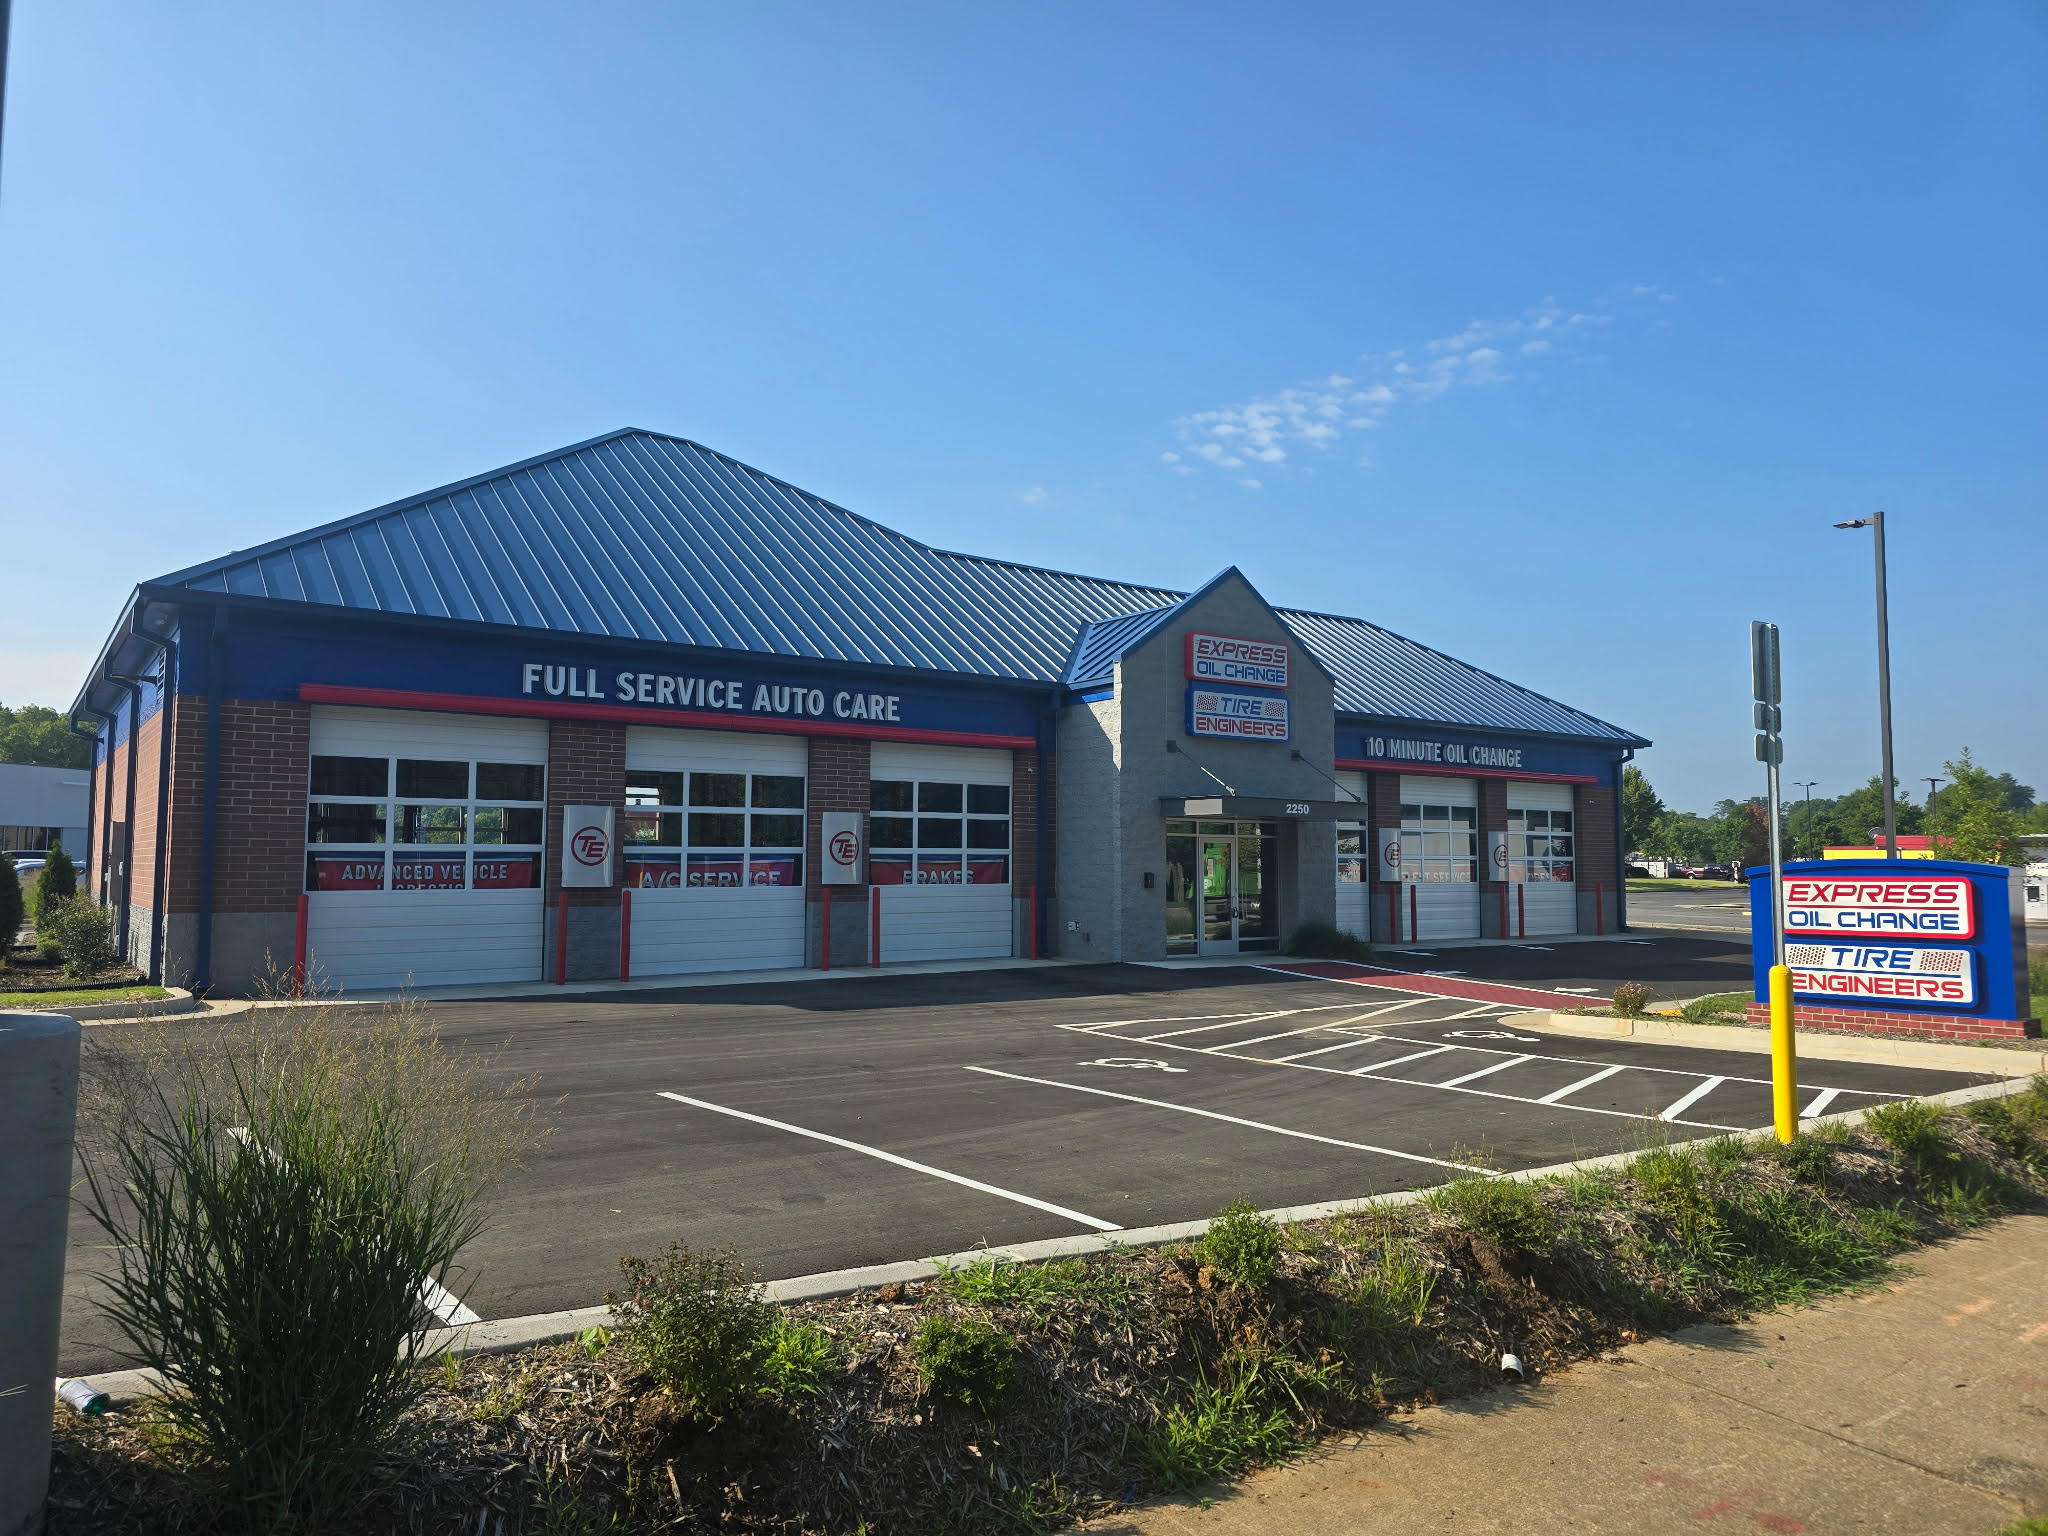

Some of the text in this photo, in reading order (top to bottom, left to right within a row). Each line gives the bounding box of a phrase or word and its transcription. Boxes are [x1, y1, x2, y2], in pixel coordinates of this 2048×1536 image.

[1196, 638, 1286, 664] EXPRESS
[1196, 660, 1286, 684] OIL CHANGE
[523, 663, 900, 722] FULL SERVICE AUTO CARE
[1220, 696, 1263, 716] TIRE
[1195, 716, 1286, 738] ENGINEERS
[1367, 736, 1522, 768] 10 MINUTE OIL CHANGE
[1286, 803, 1310, 815] 2250
[341, 864, 434, 880] ADVANCED
[440, 864, 508, 880] VEICLE
[688, 870, 781, 888] SERVICE
[1788, 883, 1959, 904] EXPRESS
[1788, 910, 1960, 931] OIL CHANGE
[1831, 947, 1914, 970] TIRE
[1791, 973, 1964, 999] ENGINEERS
